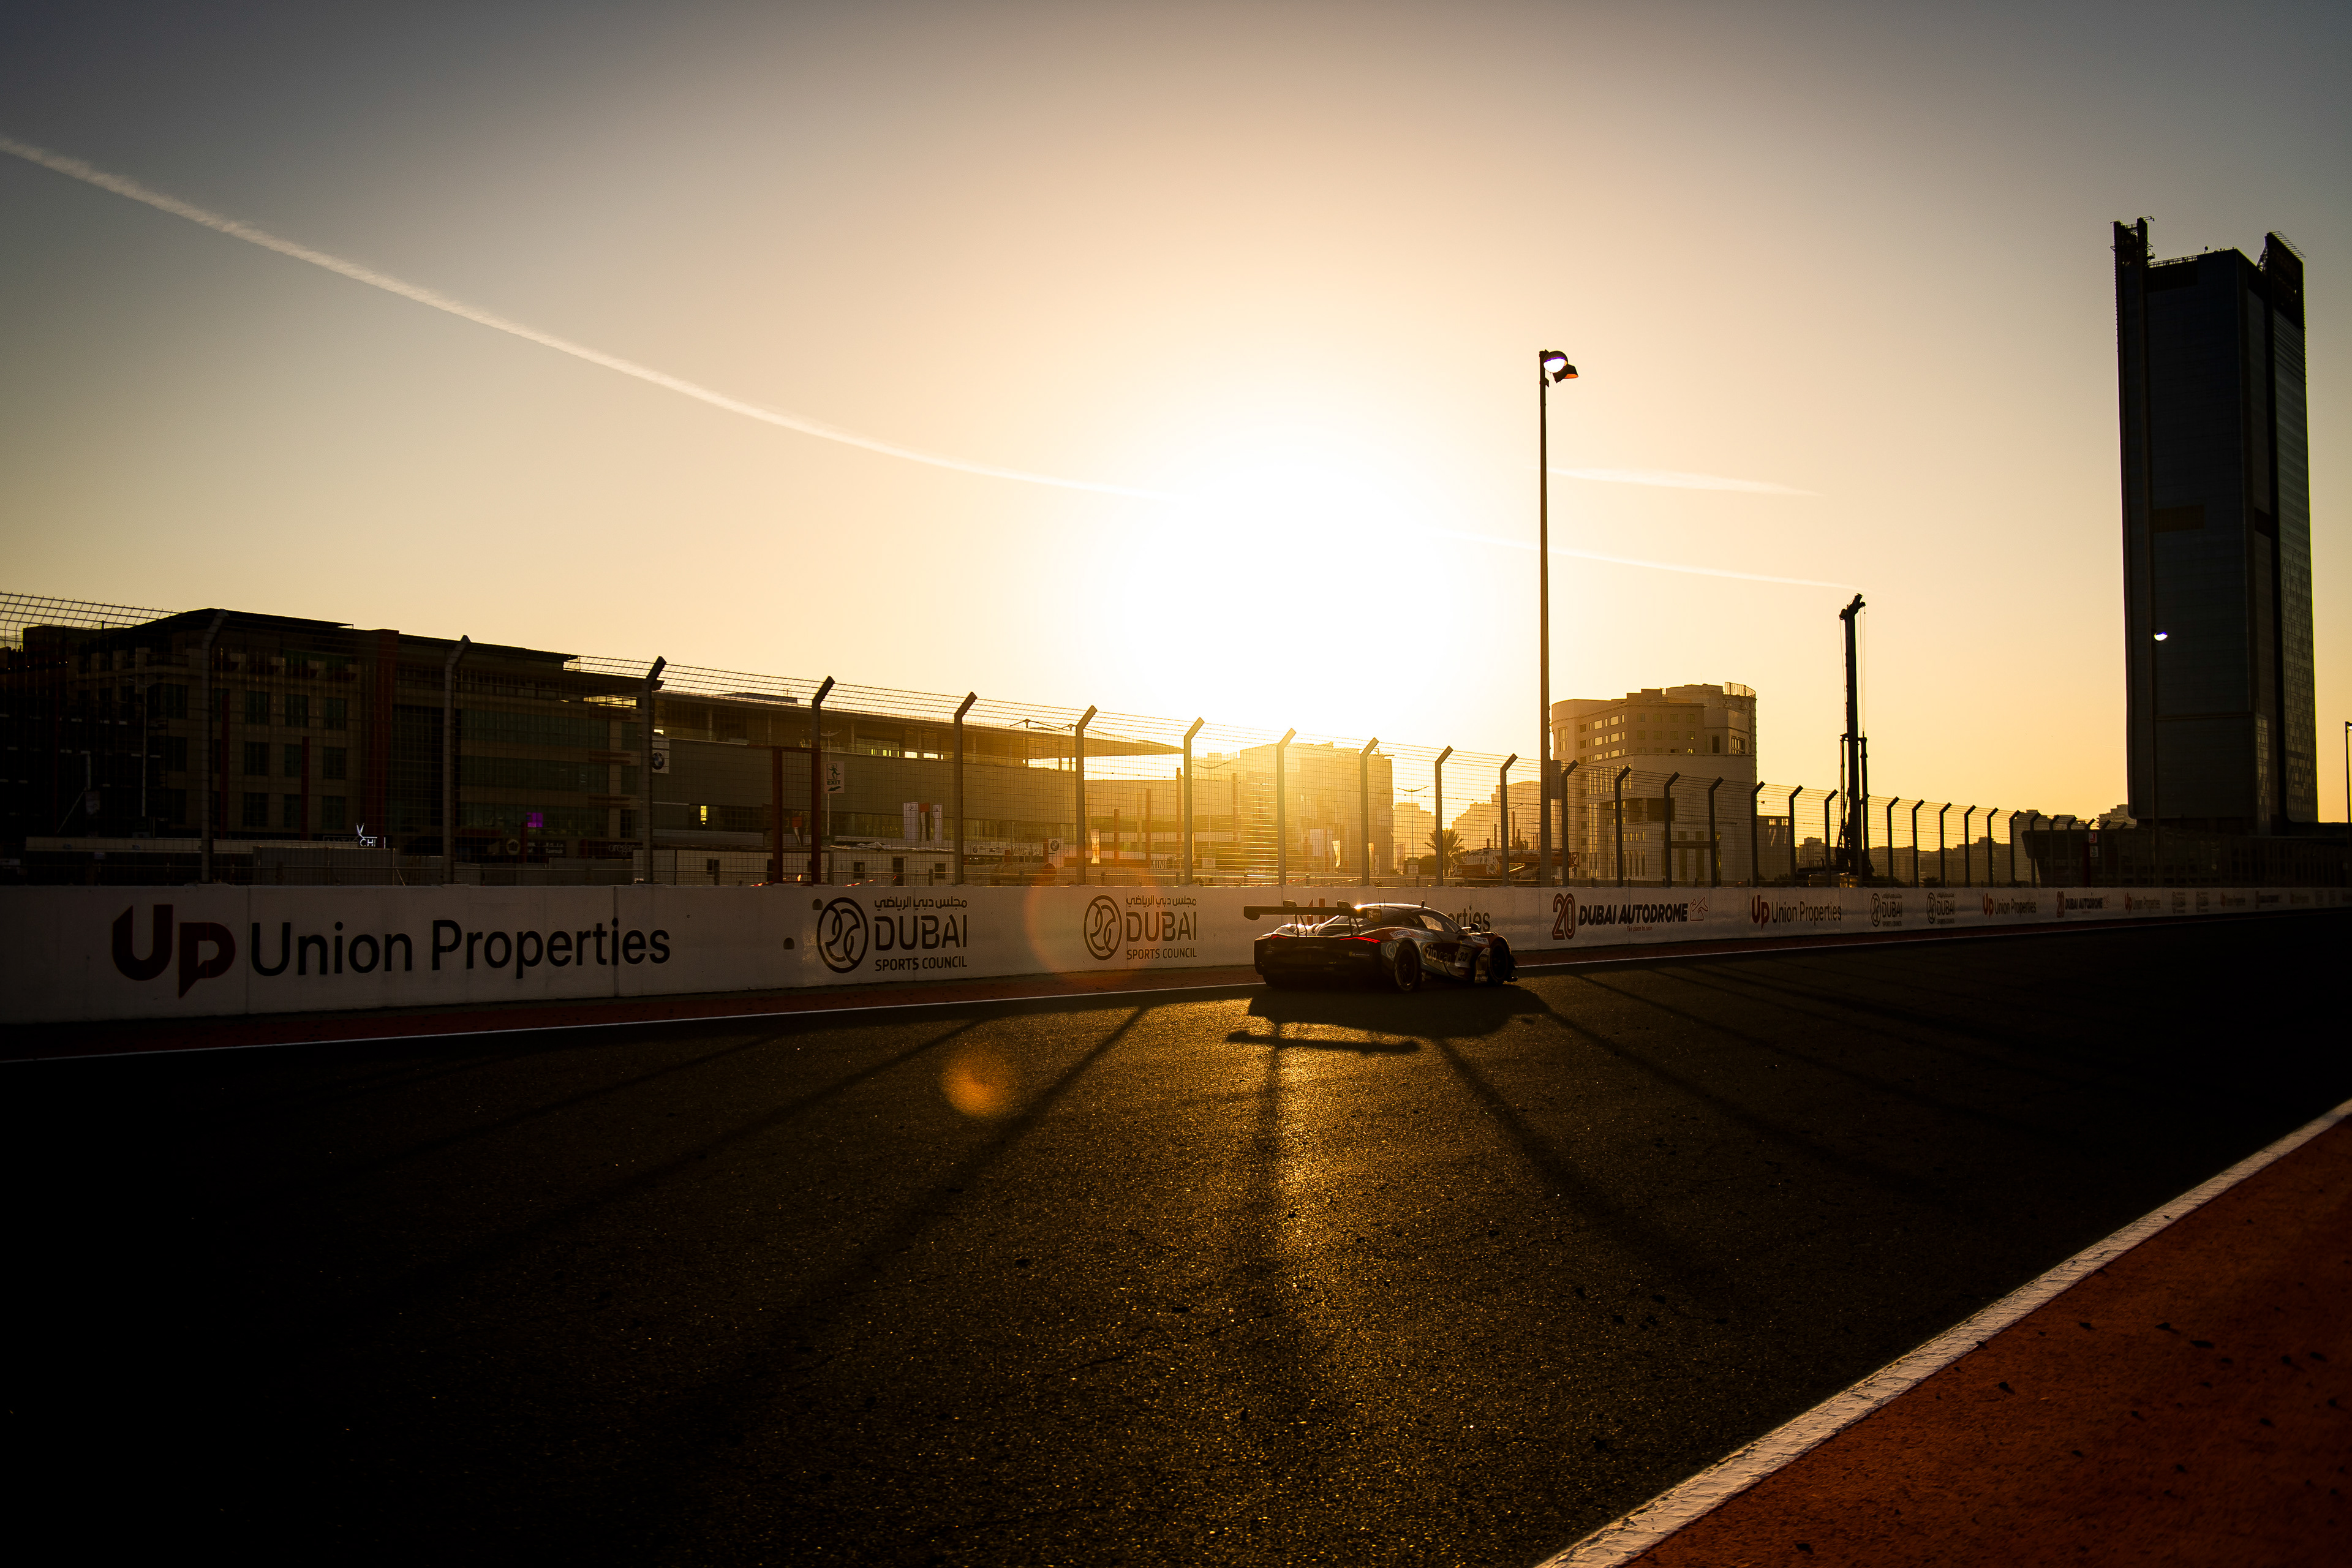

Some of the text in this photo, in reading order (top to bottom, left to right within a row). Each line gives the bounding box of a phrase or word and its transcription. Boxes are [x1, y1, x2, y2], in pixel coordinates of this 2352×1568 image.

[874, 895, 968, 911] مجلس دبي الرياضي
[1126, 894, 1197, 908] مجلس دبي الرياضي
[1882, 901, 1902, 918] DUBAI
[1937, 900, 1955, 916] DUBAI
[1994, 898, 2037, 918] Union Properties
[1551, 892, 1576, 941] 20
[1578, 904, 1617, 926] DUBAI
[1618, 903, 1689, 924] AUTODROME
[1771, 900, 1842, 925] Union Properties
[874, 914, 967, 951] DUBAI
[1126, 911, 1197, 942] DUBAI
[251, 917, 671, 979] Union Properties
[1126, 947, 1197, 960] SPORTS COUNCIL
[875, 956, 968, 971] SPORTS COUNCIL
